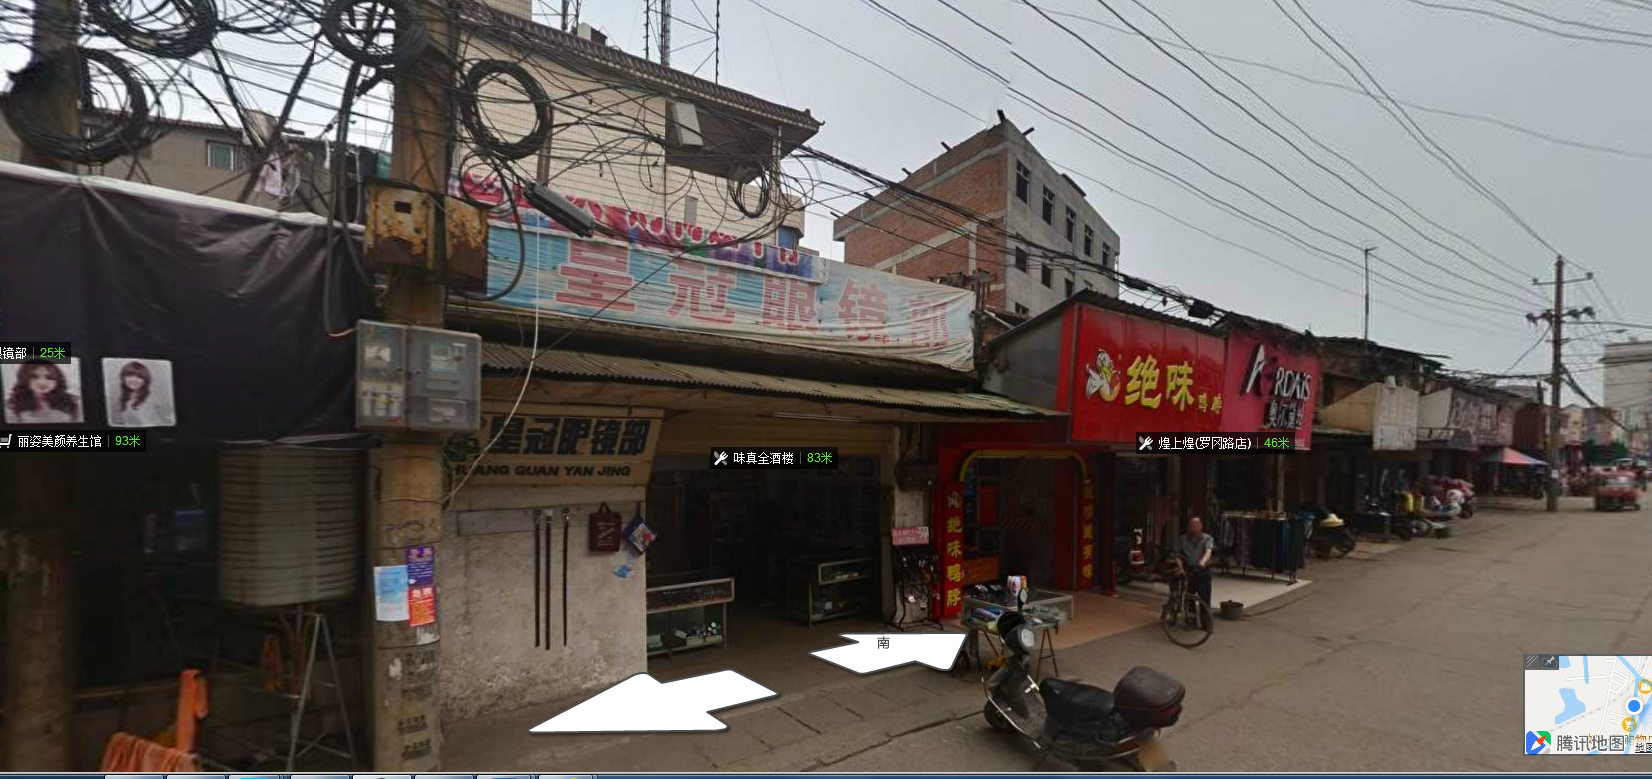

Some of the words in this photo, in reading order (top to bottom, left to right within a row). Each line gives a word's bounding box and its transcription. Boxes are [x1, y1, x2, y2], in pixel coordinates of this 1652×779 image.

[554, 237, 951, 348] 皇冠眼镜部
[1125, 355, 1195, 411] 绝味
[489, 416, 651, 455] 皇冠眼镜部
[514, 464, 560, 477] GUAN
[564, 465, 594, 477] YAN
[597, 465, 631, 477] JING
